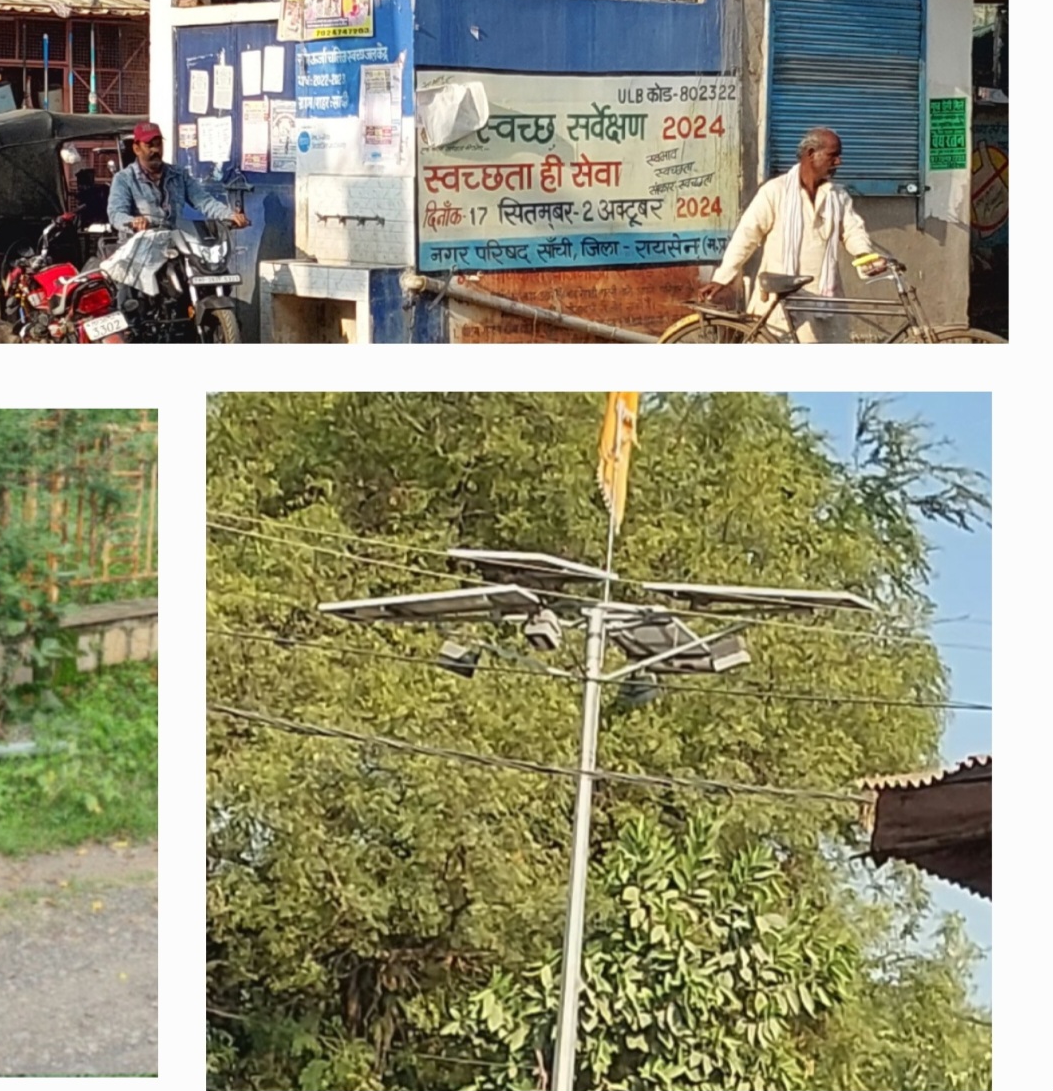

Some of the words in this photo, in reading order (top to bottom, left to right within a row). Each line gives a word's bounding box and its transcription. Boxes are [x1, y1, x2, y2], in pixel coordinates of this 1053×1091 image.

[618, 87, 643, 104] ULB
[567, 102, 648, 144] सर्वेक्षण
[662, 115, 726, 141] 2024
[424, 162, 534, 194] स्वच्छता
[540, 152, 565, 193] ही
[571, 153, 622, 188] सेवा
[469, 206, 488, 226] 17
[598, 197, 664, 226] अक्टूबर
[676, 196, 723, 219] 2024
[430, 244, 469, 264] नगर
[475, 239, 529, 265] परिषद
[581, 237, 620, 258] जिला
